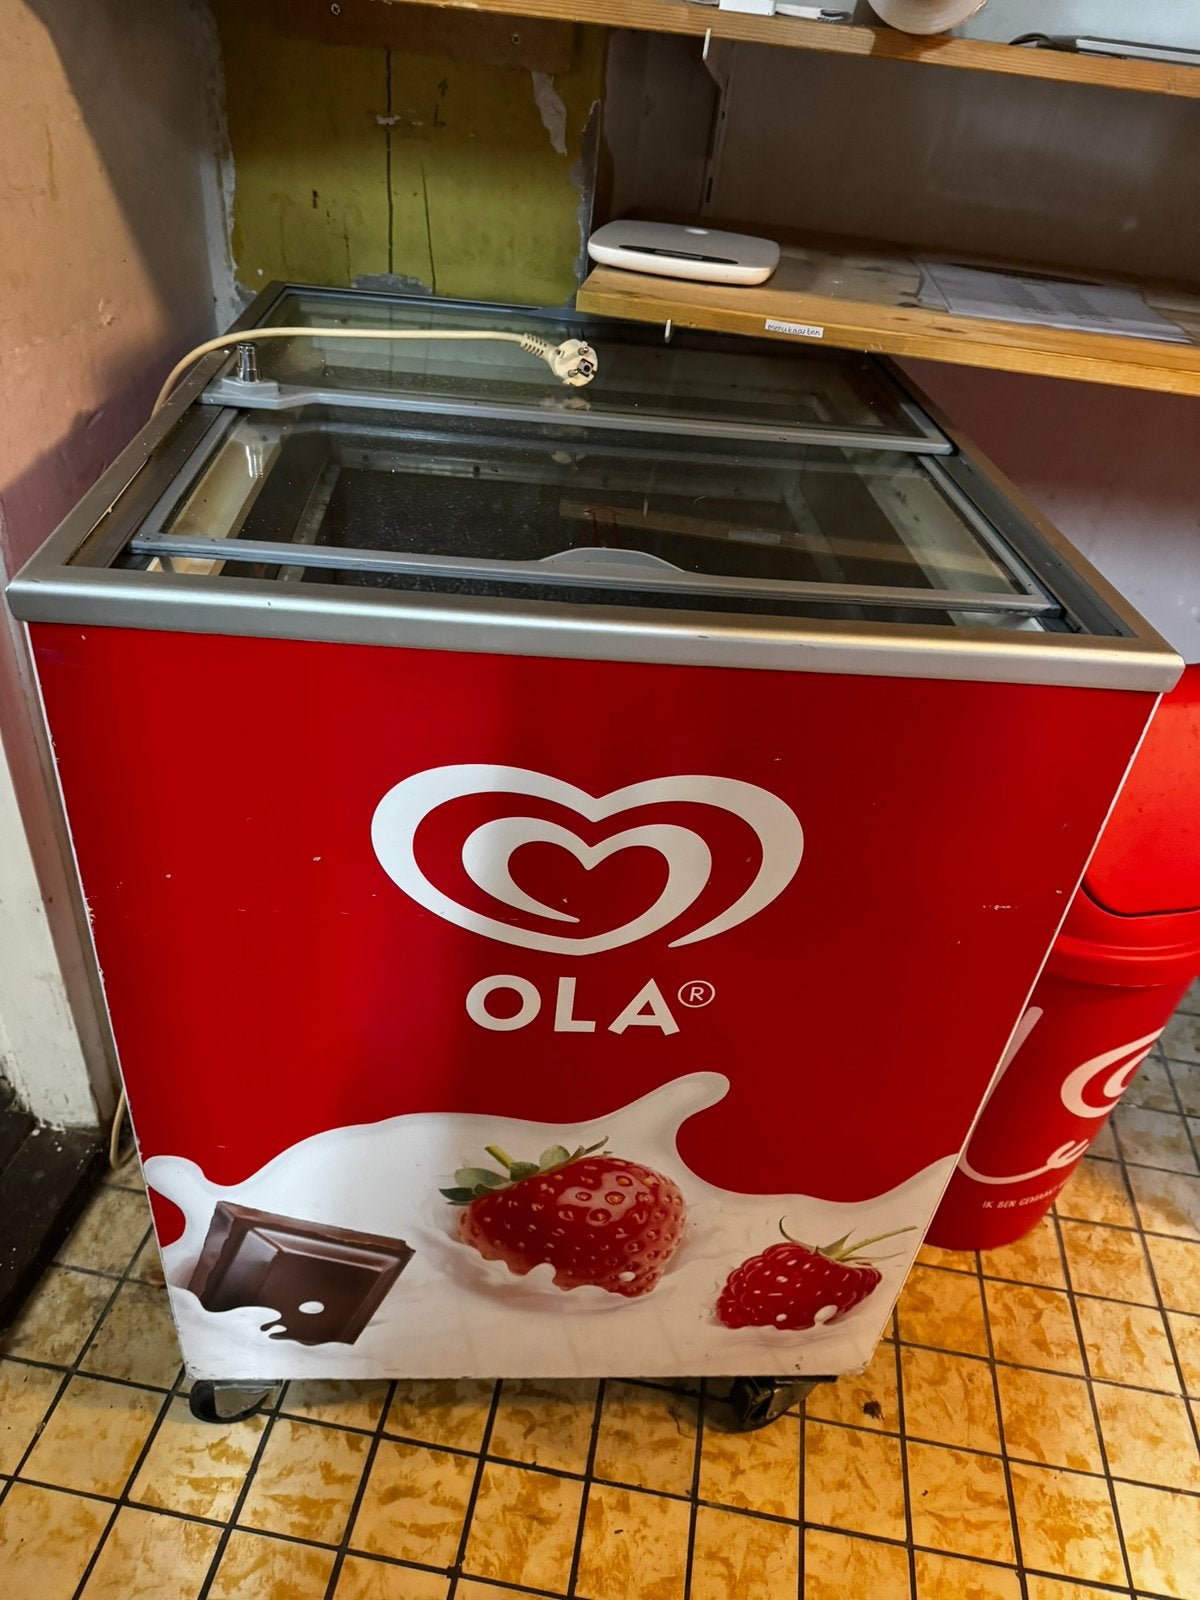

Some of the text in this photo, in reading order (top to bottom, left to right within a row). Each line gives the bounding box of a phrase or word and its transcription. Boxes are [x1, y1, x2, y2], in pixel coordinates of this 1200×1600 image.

[465, 974, 680, 1036] OLA
[982, 1200, 994, 1209] IK
[996, 1200, 1016, 1209] BEN
